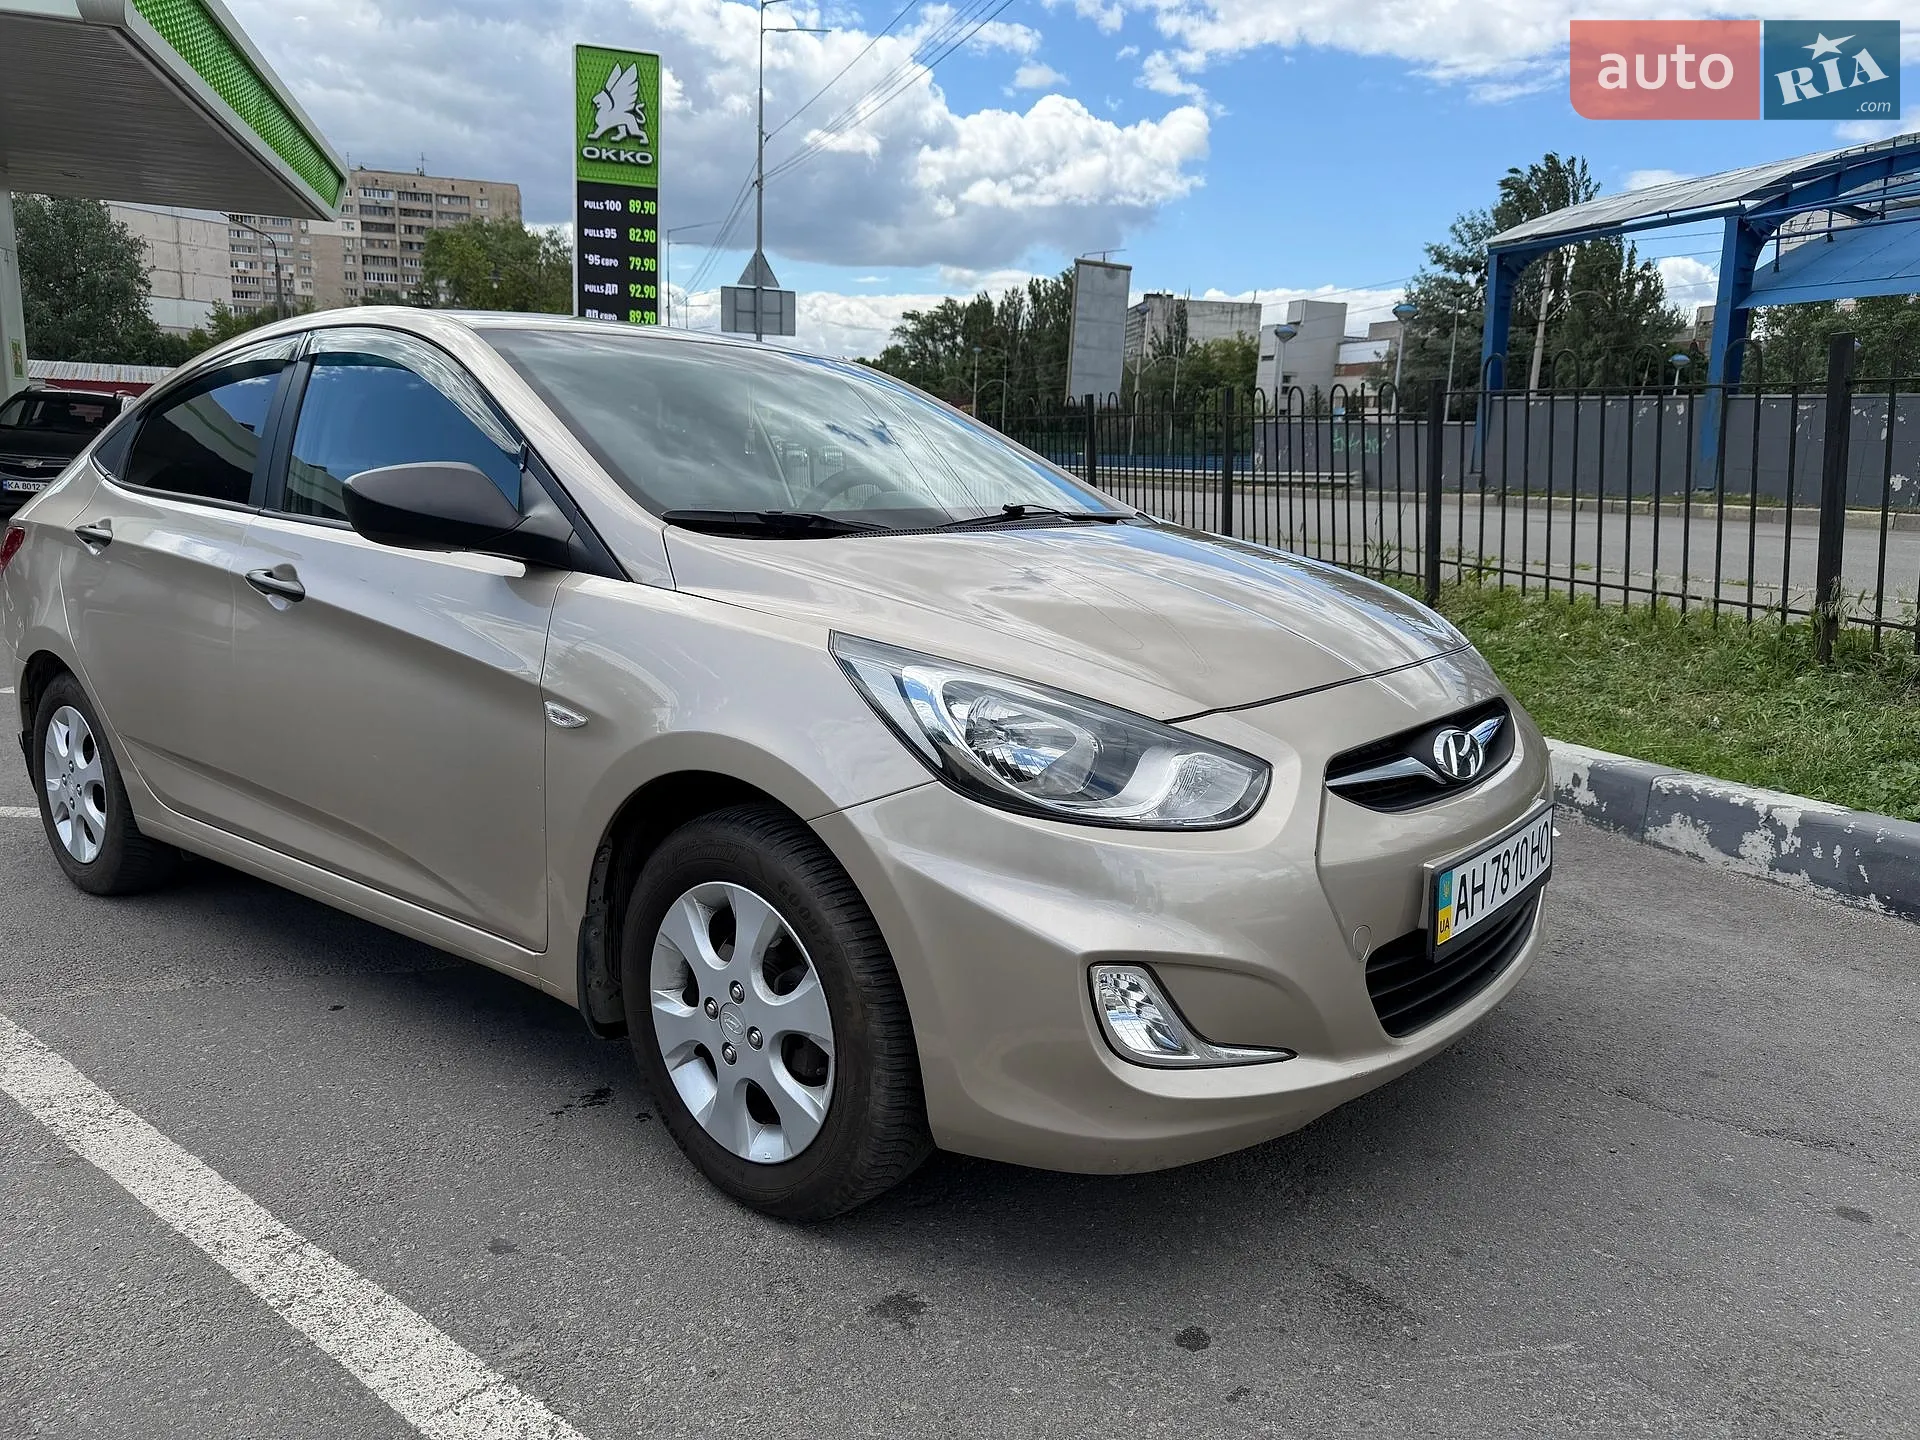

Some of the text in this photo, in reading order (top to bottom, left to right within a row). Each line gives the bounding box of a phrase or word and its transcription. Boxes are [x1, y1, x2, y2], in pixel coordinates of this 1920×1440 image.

[582, 146, 653, 165] OKKO
[629, 199, 656, 215] 89.90
[629, 227, 656, 243] 82.90
[629, 255, 656, 272] 79.90
[629, 283, 656, 299] 92.90
[629, 309, 656, 325] 89.90
[7, 481, 20, 489] KA
[1454, 820, 1549, 927] AH 7810 HO
[1439, 918, 1450, 934] UA
